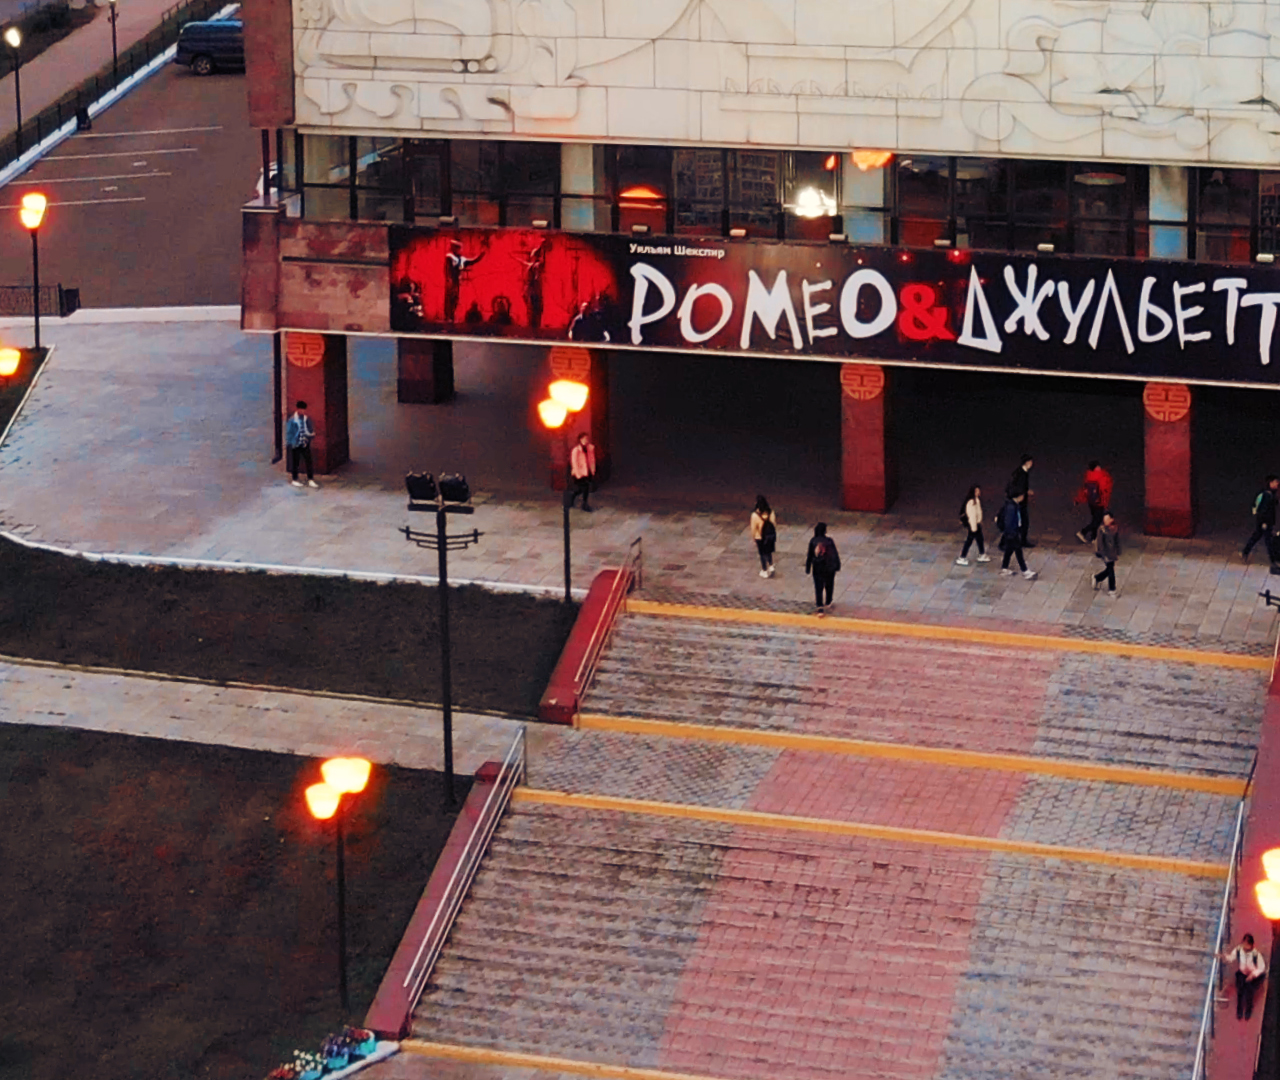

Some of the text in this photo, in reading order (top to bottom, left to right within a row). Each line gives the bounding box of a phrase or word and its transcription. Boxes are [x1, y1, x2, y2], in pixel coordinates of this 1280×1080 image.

[629, 243, 725, 259] Уильям Шекспир
[627, 261, 898, 350] РОМЕО
[897, 282, 956, 342] &
